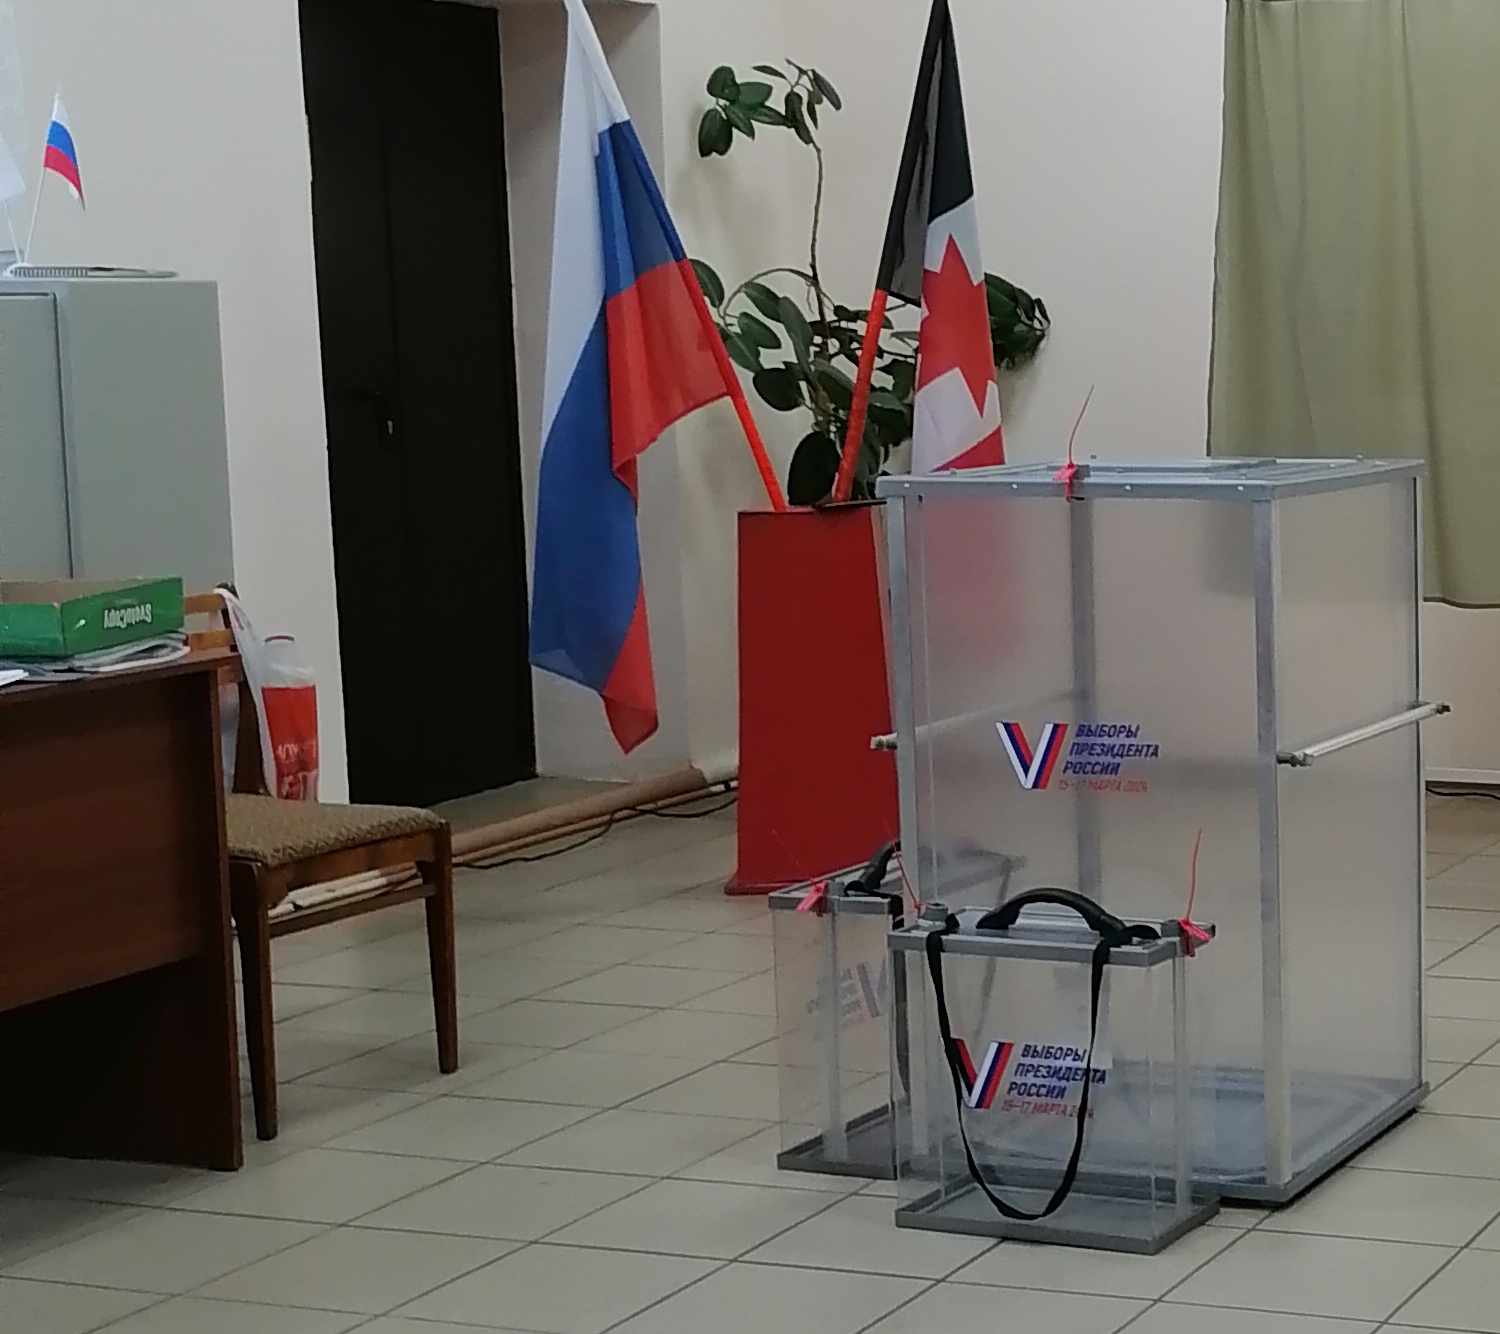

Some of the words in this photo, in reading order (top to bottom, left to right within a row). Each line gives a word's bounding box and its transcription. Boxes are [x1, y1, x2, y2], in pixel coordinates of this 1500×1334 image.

[1075, 723, 1141, 739] ВЫБОРЫ
[1069, 742, 1159, 758] ПРЕЗИДЕНТА
[1062, 760, 1121, 776] РОССИИ
[1021, 1043, 1087, 1062] ВЫБОРЫ
[1007, 1081, 1067, 1100] РОССИИ
